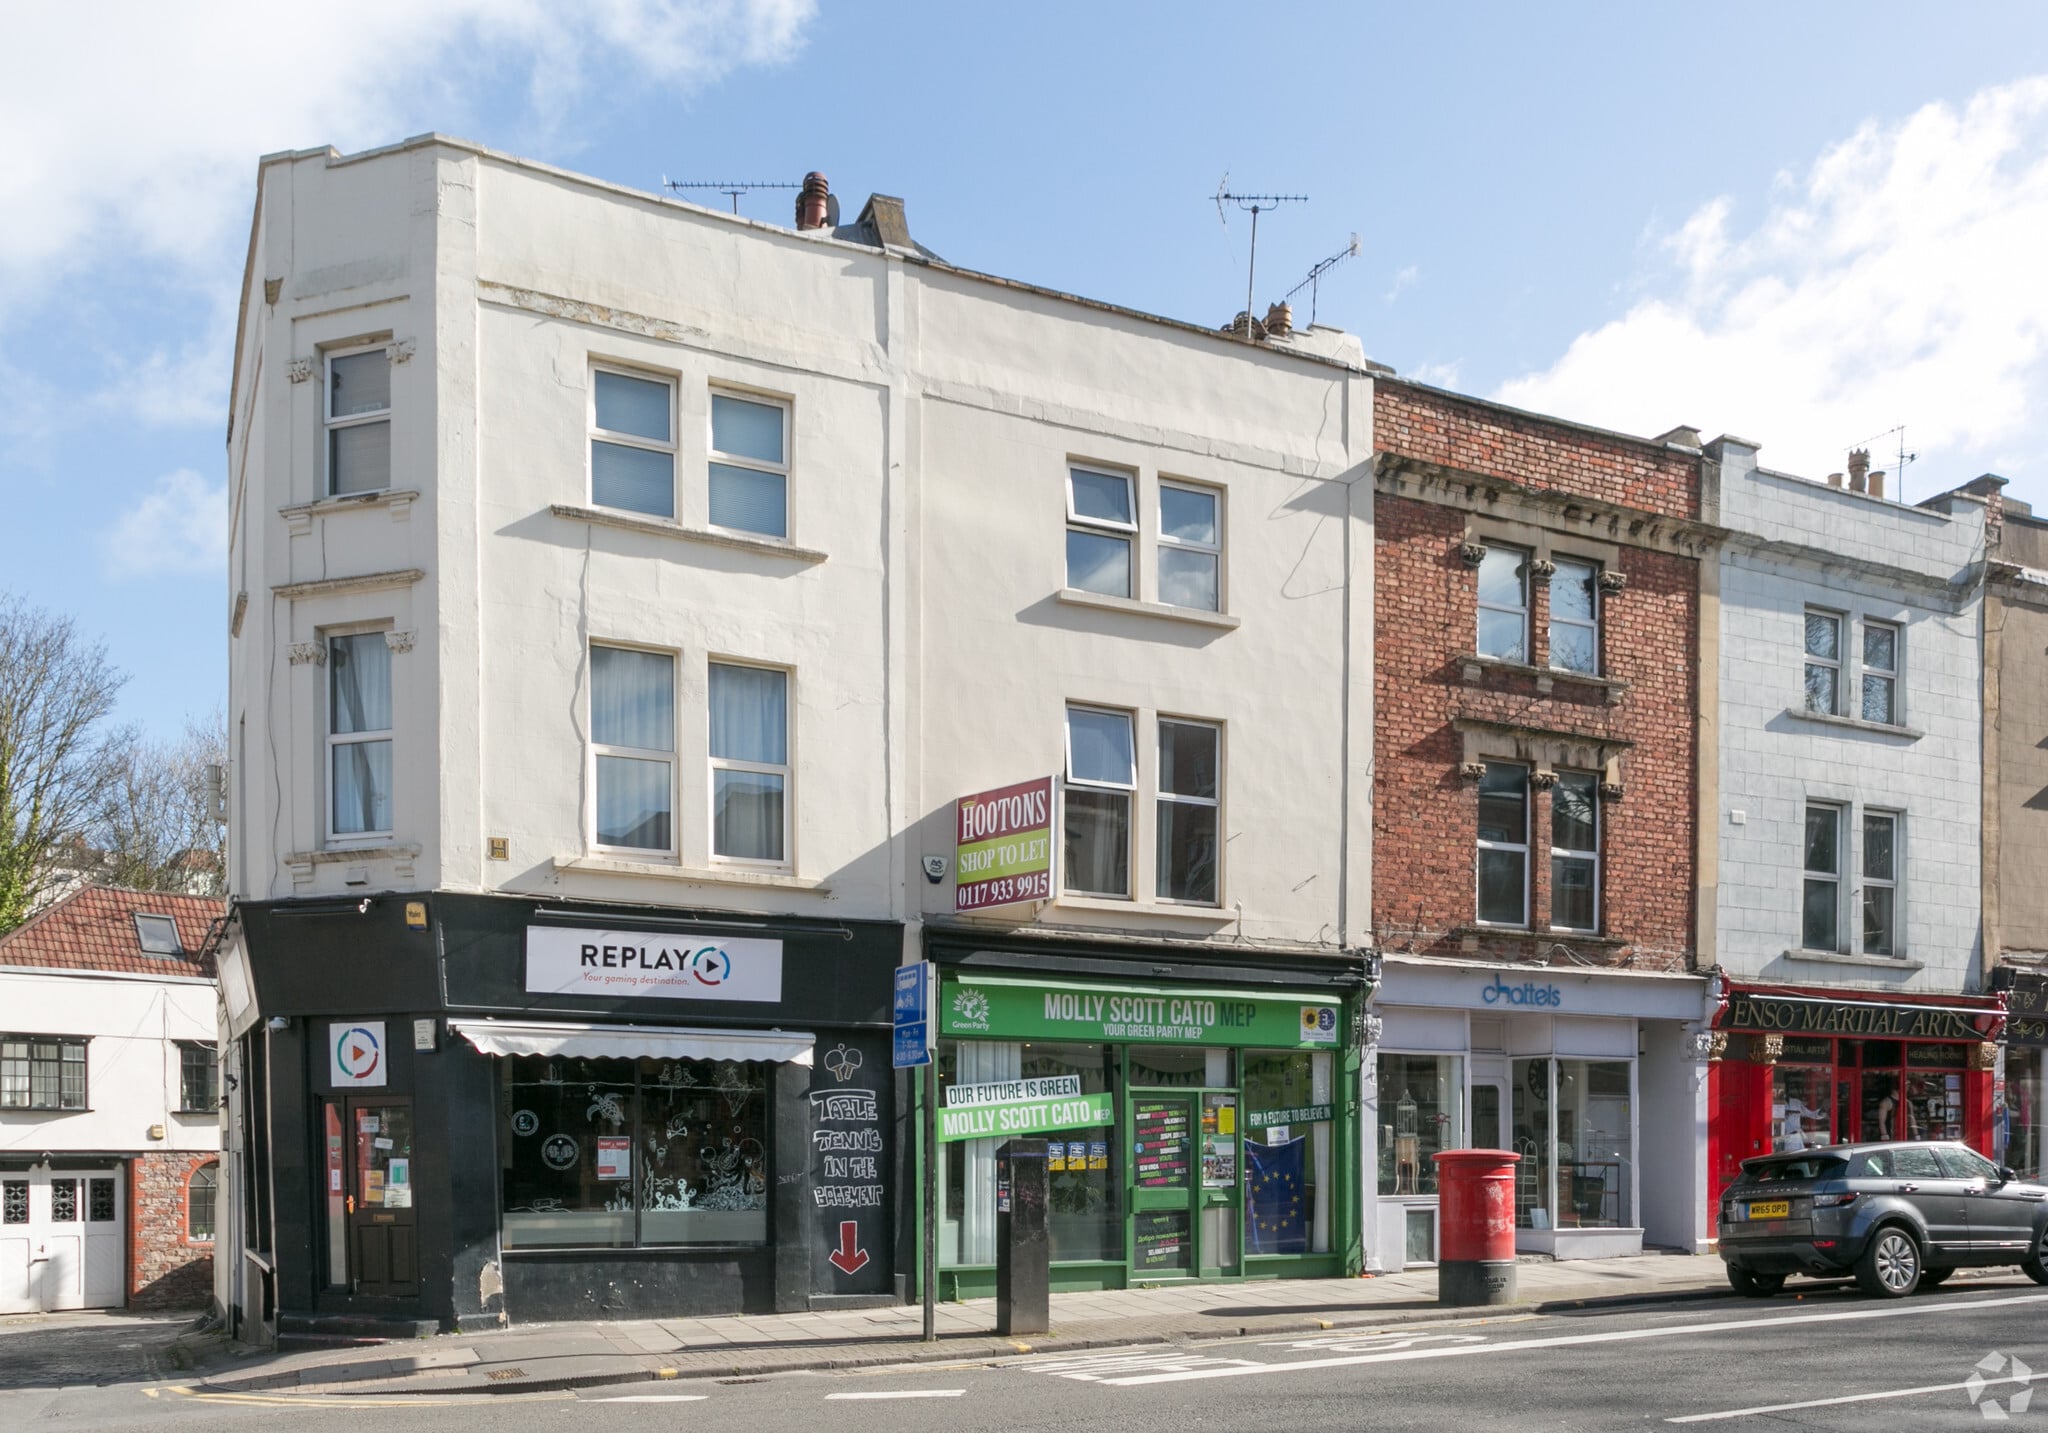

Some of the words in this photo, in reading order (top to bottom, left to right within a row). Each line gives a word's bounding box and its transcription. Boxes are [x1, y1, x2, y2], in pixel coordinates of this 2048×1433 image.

[961, 789, 1047, 840] HOOTONS
[960, 848, 995, 873] SHOP
[997, 844, 1017, 866] TO
[1020, 838, 1047, 862] LET
[959, 883, 988, 906] 0117
[991, 878, 1014, 902] 933
[1017, 872, 1048, 898] 9915
[581, 944, 691, 971] REPLAY
[583, 972, 603, 982] Your
[604, 974, 637, 986] gaming
[639, 976, 690, 986] destination.
[1482, 972, 1561, 1007] chattels
[1044, 993, 1105, 1022] MOLLY
[1109, 997, 1166, 1024] SCOTT
[1170, 999, 1215, 1026] CATO
[1220, 1001, 1256, 1027] MEP
[1732, 999, 1794, 1028] ENSO
[1801, 1004, 1903, 1034] MARTIAL
[1908, 1010, 1967, 1038] ARTS
[952, 1021, 972, 1029] Green
[972, 1021, 990, 1032] Party
[1103, 1023, 1126, 1036] YOUR
[1127, 1024, 1155, 1037] GREEN
[1156, 1025, 1183, 1038] PARTY
[1184, 1026, 1203, 1039] MEP
[809, 1088, 878, 1122] TABLE
[949, 1087, 974, 1105] OUR
[977, 1082, 1023, 1102] FUTURE
[1026, 1080, 1037, 1098] IS
[1040, 1077, 1078, 1096] GREEN
[943, 1109, 995, 1136] MOLLY
[999, 1105, 1048, 1131] SCOTT
[1051, 1101, 1090, 1125] CATO
[1093, 1108, 1111, 1121] MEP
[1250, 1112, 1263, 1126] FOR
[1263, 1112, 1268, 1125] A
[1268, 1110, 1291, 1124] FUTURE
[1291, 1109, 1299, 1122] TO
[1299, 1106, 1324, 1121] BELIEVE
[1324, 1106, 1331, 1118] IN
[813, 1128, 883, 1151] TENNIS
[824, 1155, 848, 1177] IN
[849, 1156, 877, 1179] THE
[813, 1185, 883, 1208] BASEMENT
